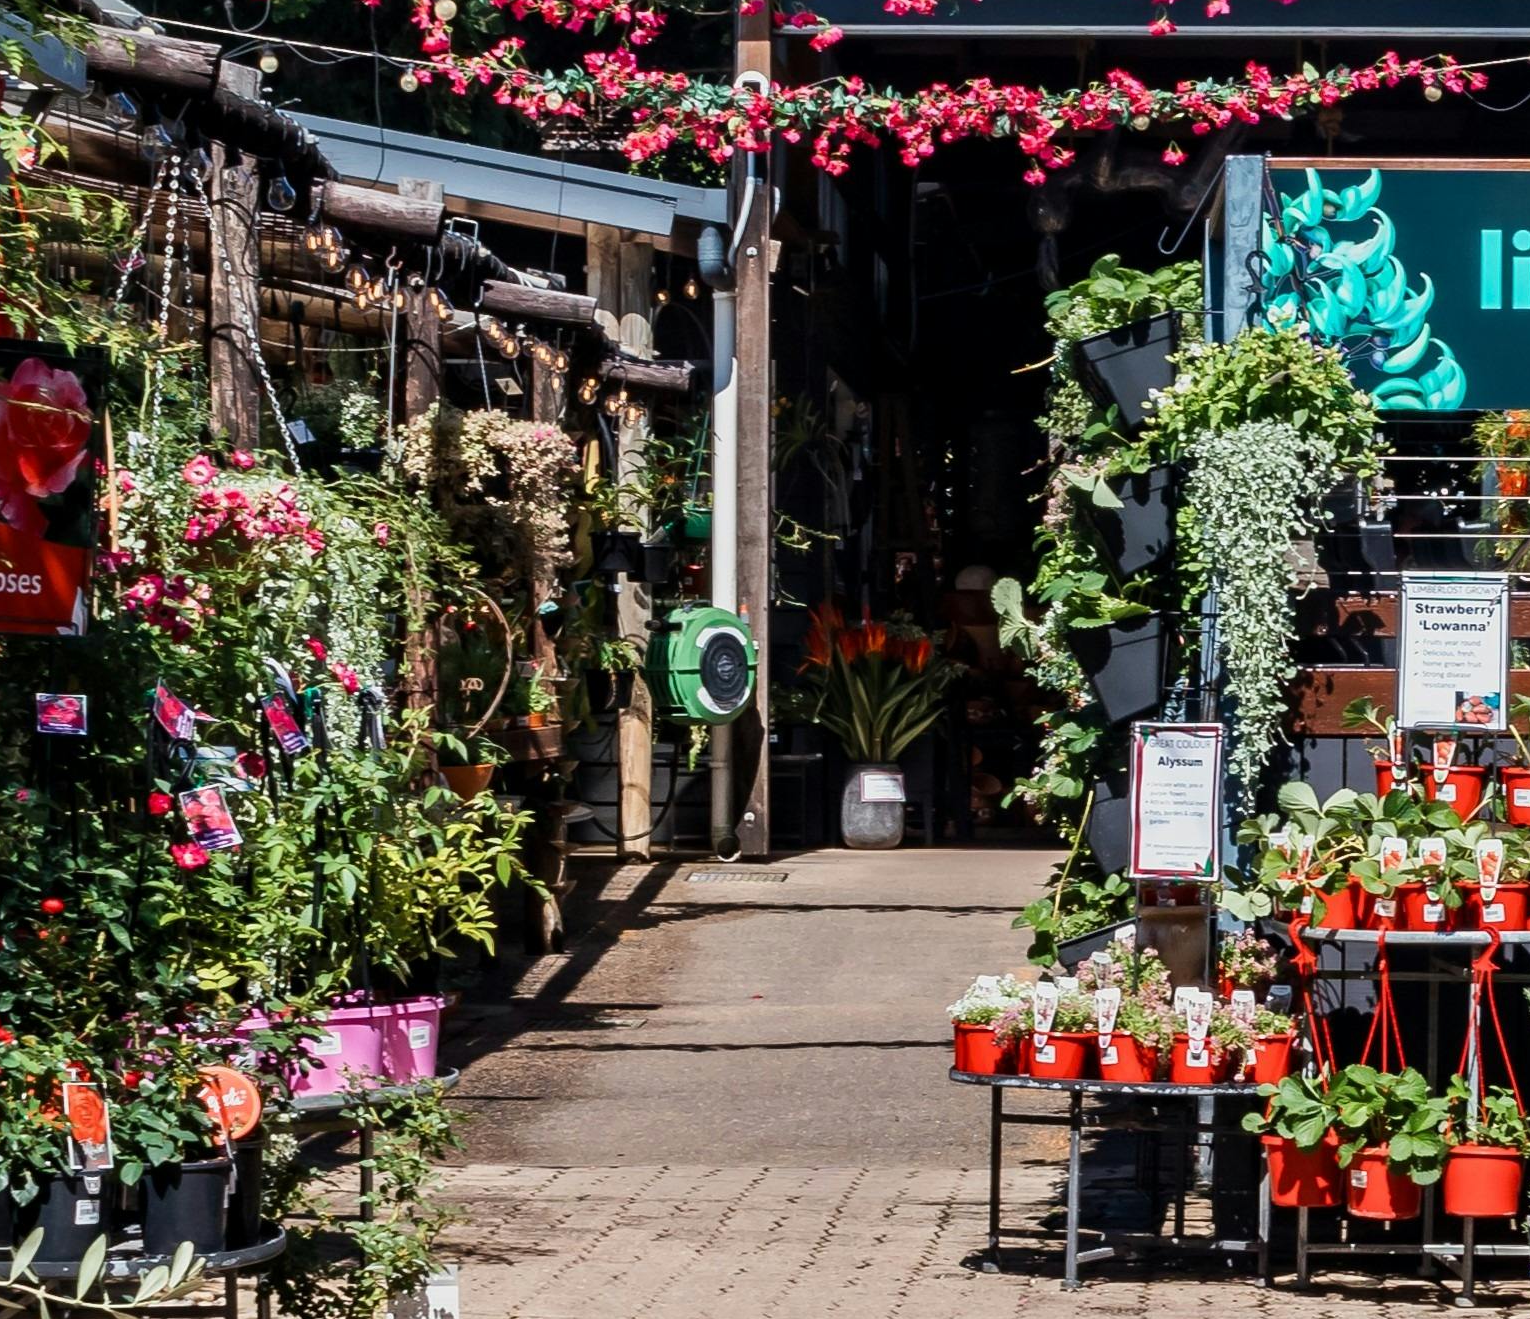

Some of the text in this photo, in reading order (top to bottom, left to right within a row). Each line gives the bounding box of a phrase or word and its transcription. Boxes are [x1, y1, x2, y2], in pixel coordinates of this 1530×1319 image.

[1412, 585, 1463, 594] LIMBERLOST
[1415, 603, 1495, 617] Strawberry
[1157, 756, 1204, 769] Alyssum
